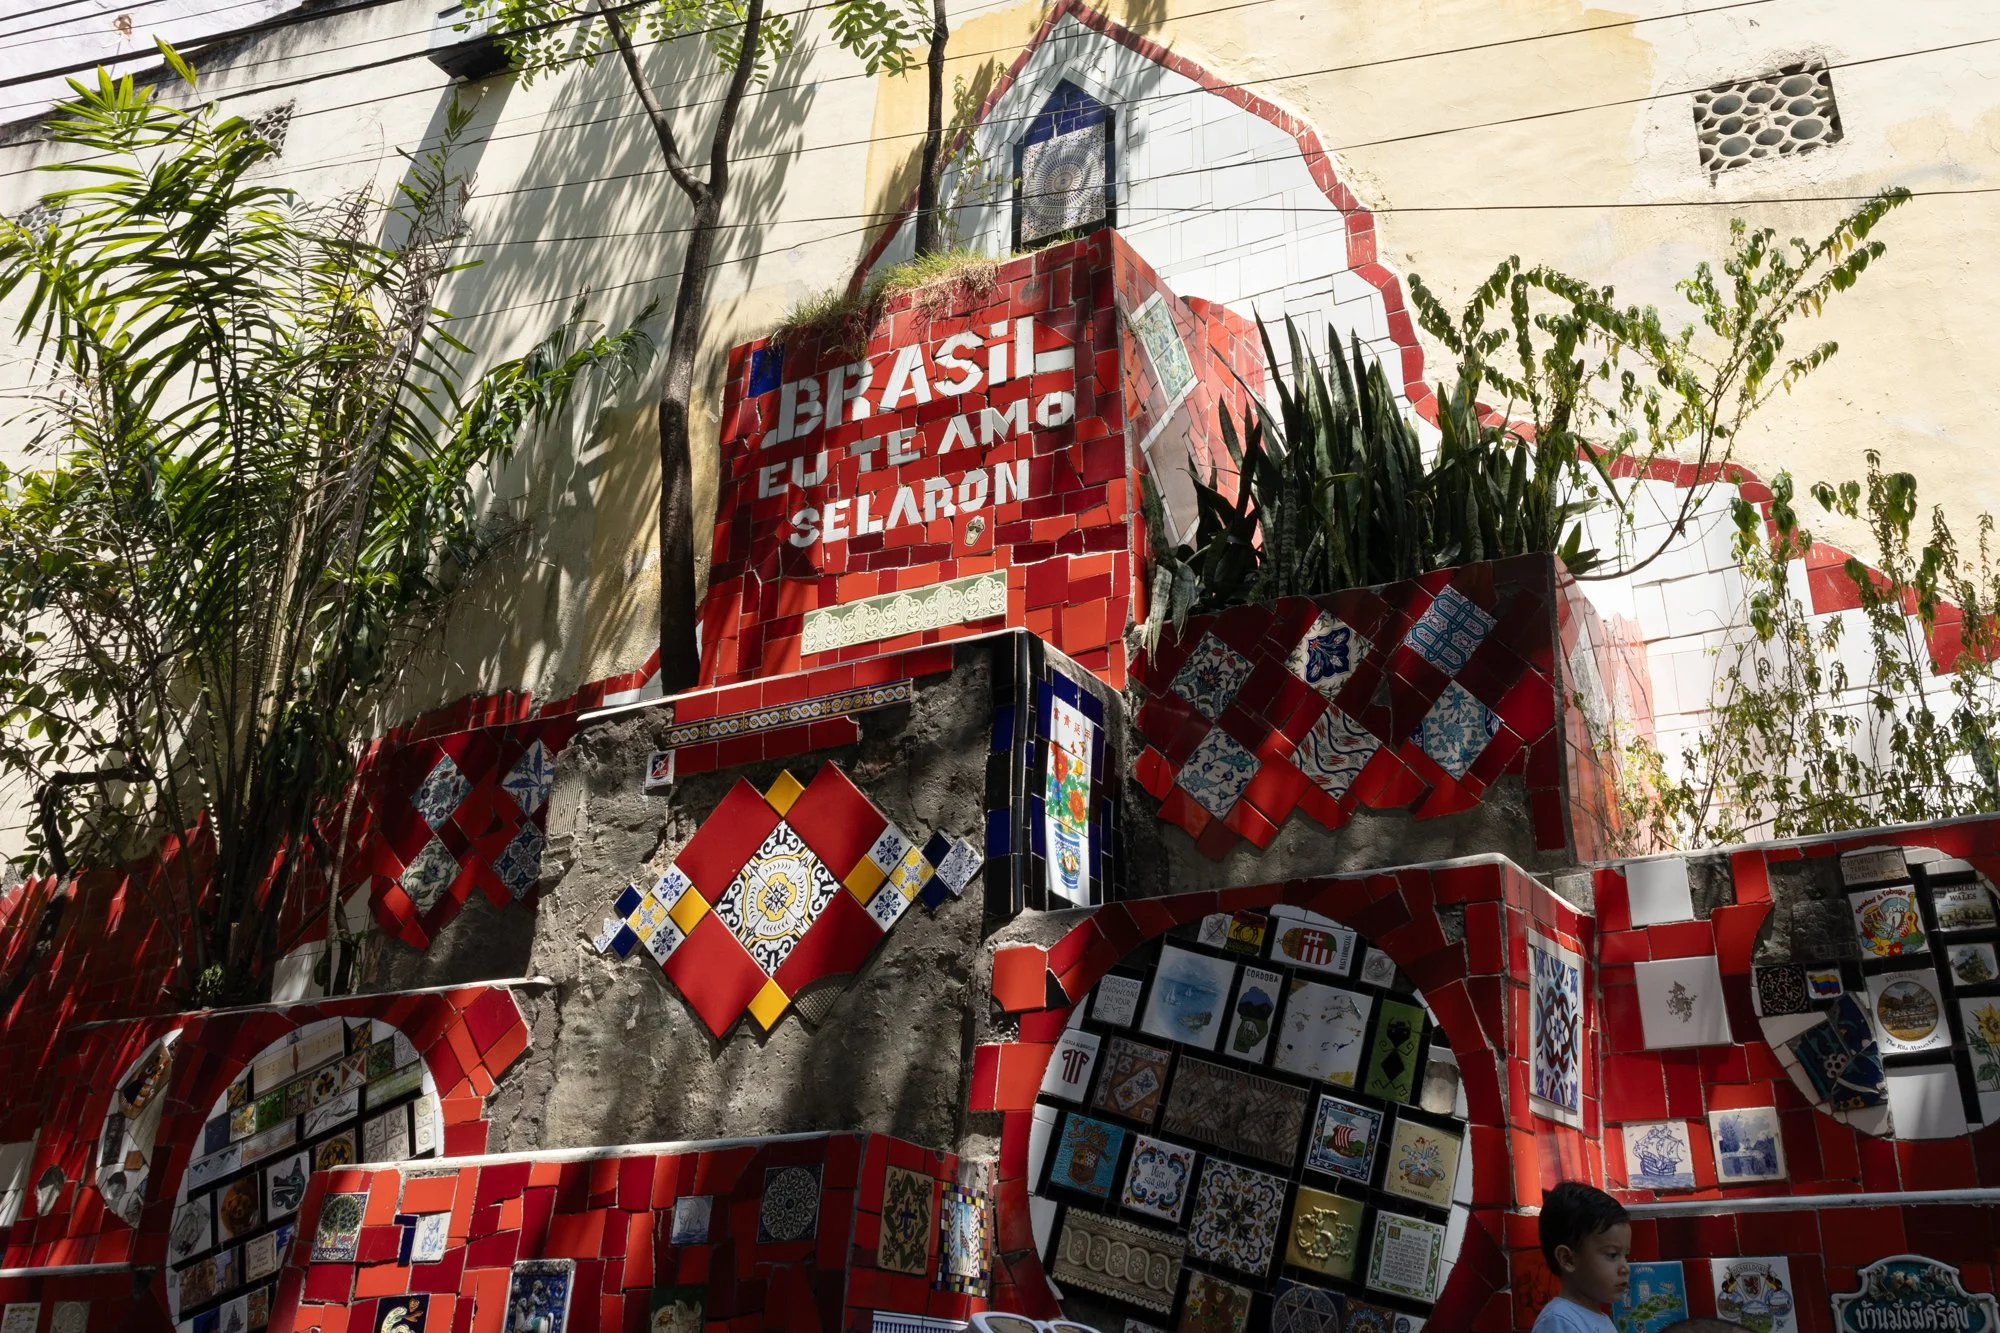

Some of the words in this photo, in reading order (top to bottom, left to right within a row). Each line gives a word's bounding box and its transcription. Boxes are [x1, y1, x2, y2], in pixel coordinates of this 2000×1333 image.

[758, 451, 829, 499] EU
[850, 427, 920, 473] TE
[937, 391, 1076, 455] AMO
[789, 458, 1030, 548] SELARON
[1881, 887, 1907, 897] Tobago
[1949, 893, 1977, 901] WALES
[1246, 968, 1279, 983] CORDOBA
[1100, 983, 1139, 999] SNOWCONE
[1104, 994, 1113, 1003] IN
[1115, 996, 1131, 1007] YOUR
[1103, 1003, 1130, 1016] EYE
[1886, 1037, 1896, 1047] The
